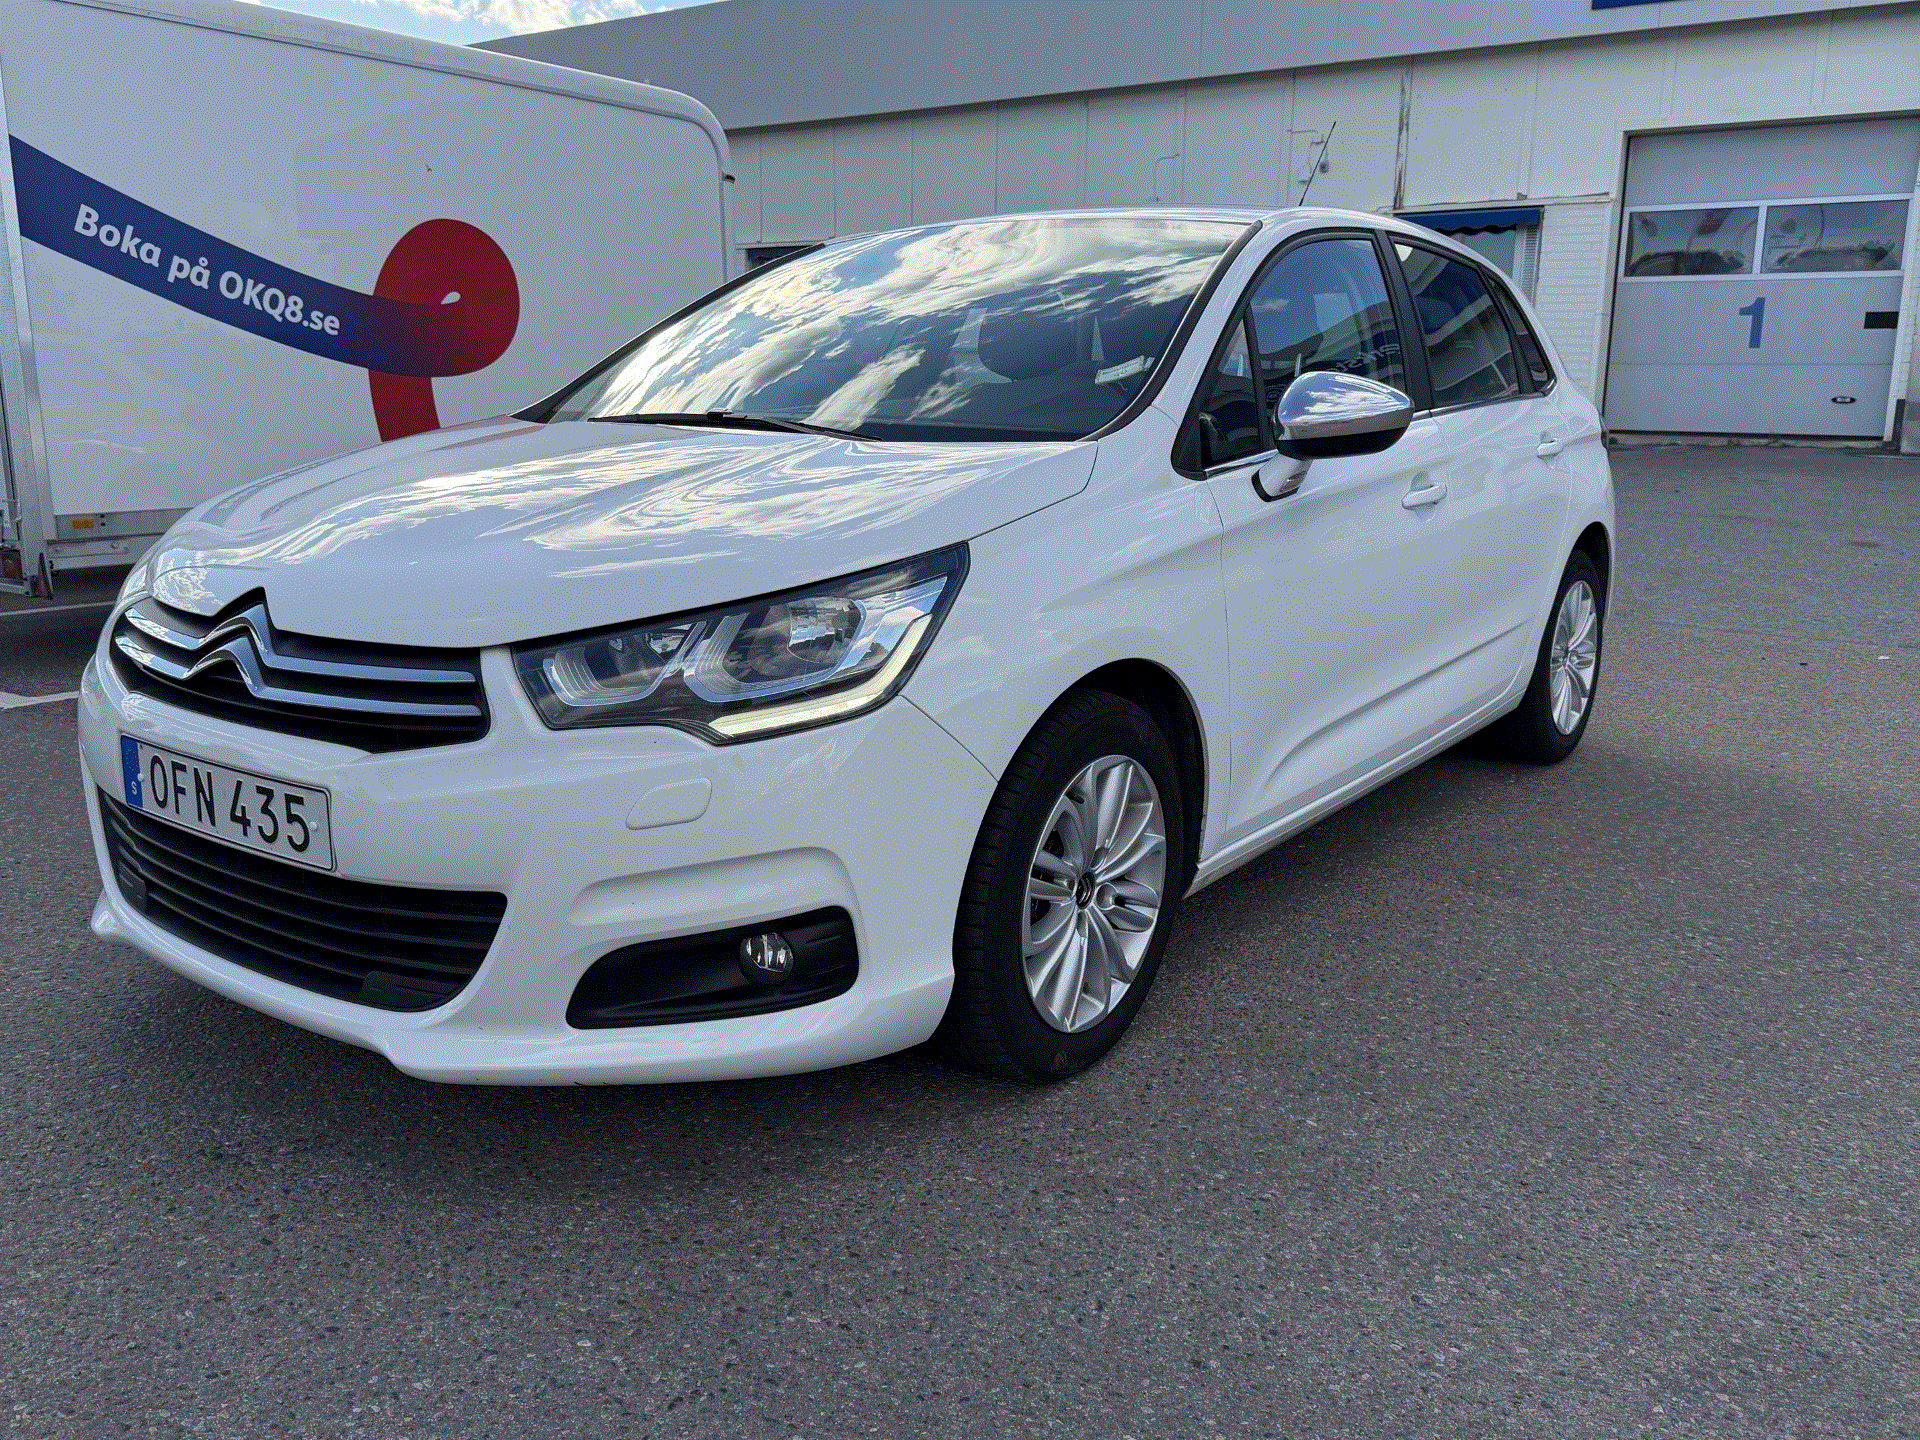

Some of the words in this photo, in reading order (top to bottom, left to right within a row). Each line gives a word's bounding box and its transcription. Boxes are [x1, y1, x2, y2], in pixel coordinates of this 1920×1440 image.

[74, 203, 161, 268] Boka
[167, 256, 210, 290] på
[219, 270, 340, 336] OKQ8.se
[1739, 296, 1766, 349] 1
[131, 780, 138, 796] S
[150, 754, 216, 827] OFN
[229, 780, 310, 853] 435
